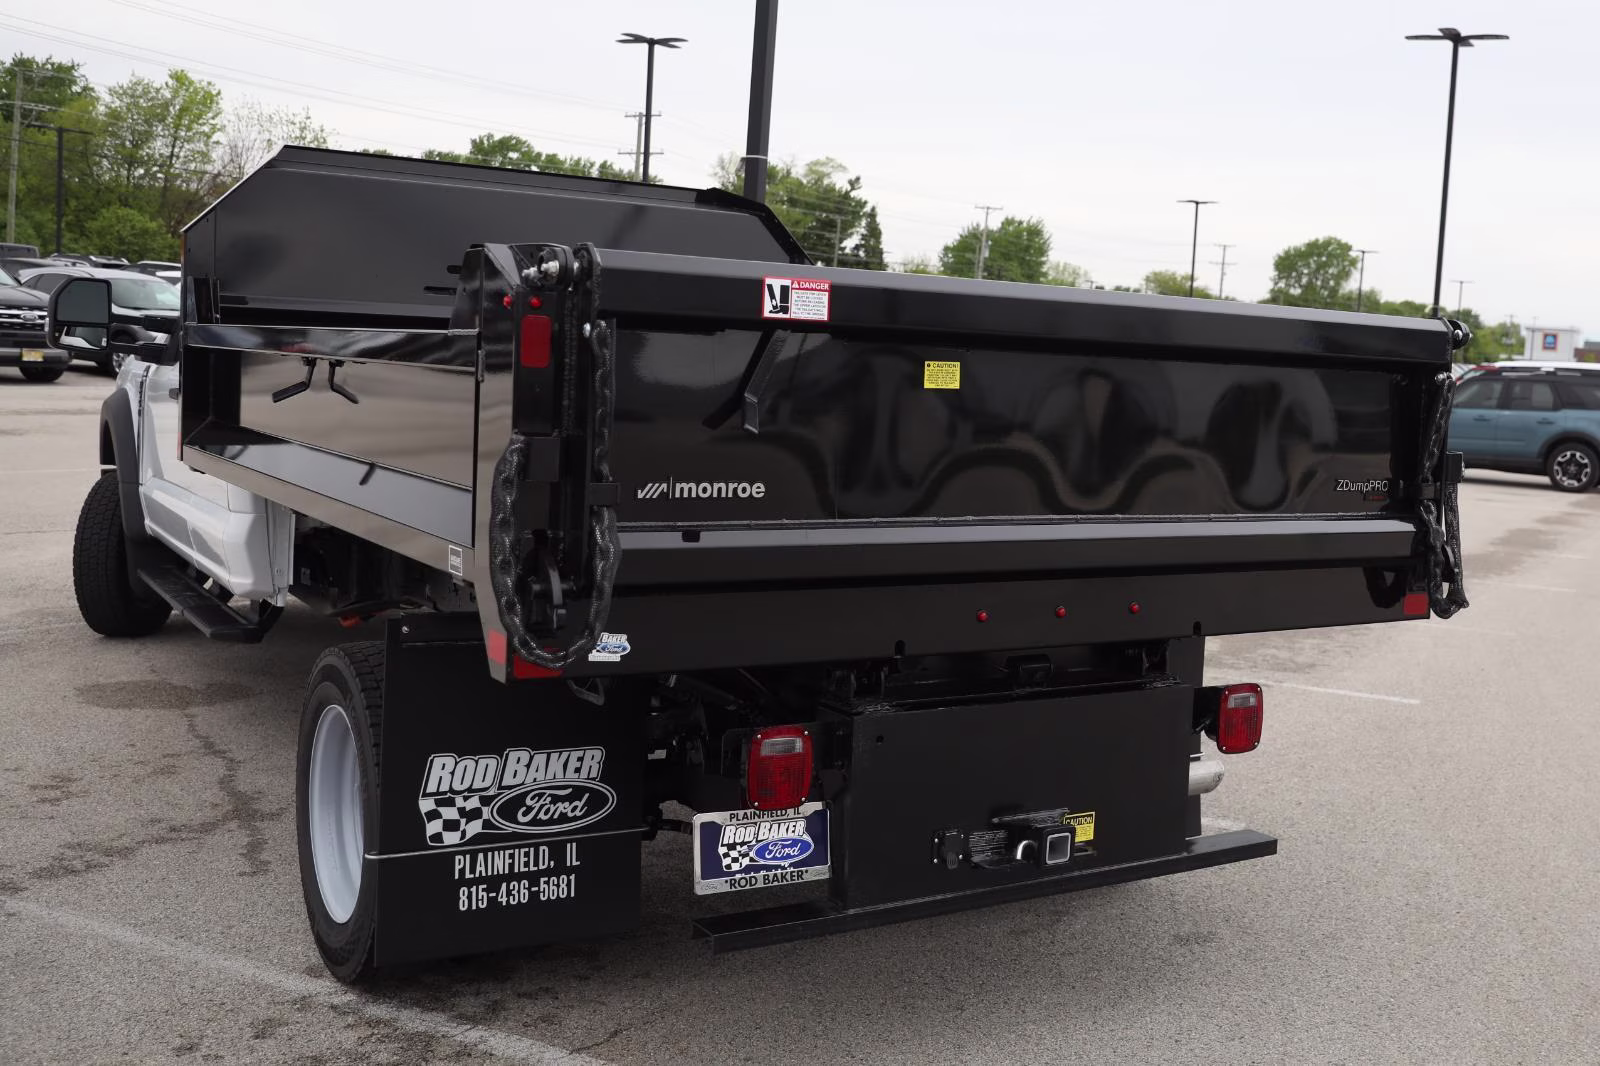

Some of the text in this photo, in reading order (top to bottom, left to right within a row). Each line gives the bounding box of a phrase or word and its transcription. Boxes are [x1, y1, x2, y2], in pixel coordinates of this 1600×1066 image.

[800, 281, 830, 290] DANGER
[675, 482, 766, 498] monroe
[1336, 479, 1388, 494] ZDumpPRO
[601, 634, 627, 643] BAKER
[425, 749, 602, 793] ROD BAKER
[517, 788, 590, 823] Ford
[729, 807, 802, 822] PLAINFIELD, IL
[1065, 816, 1093, 826] CAUTION
[722, 820, 806, 845] ROD BAKER
[765, 840, 801, 859] Ford
[454, 842, 581, 880] PLAINFIELD, IL
[458, 873, 576, 911] 815-436-5681
